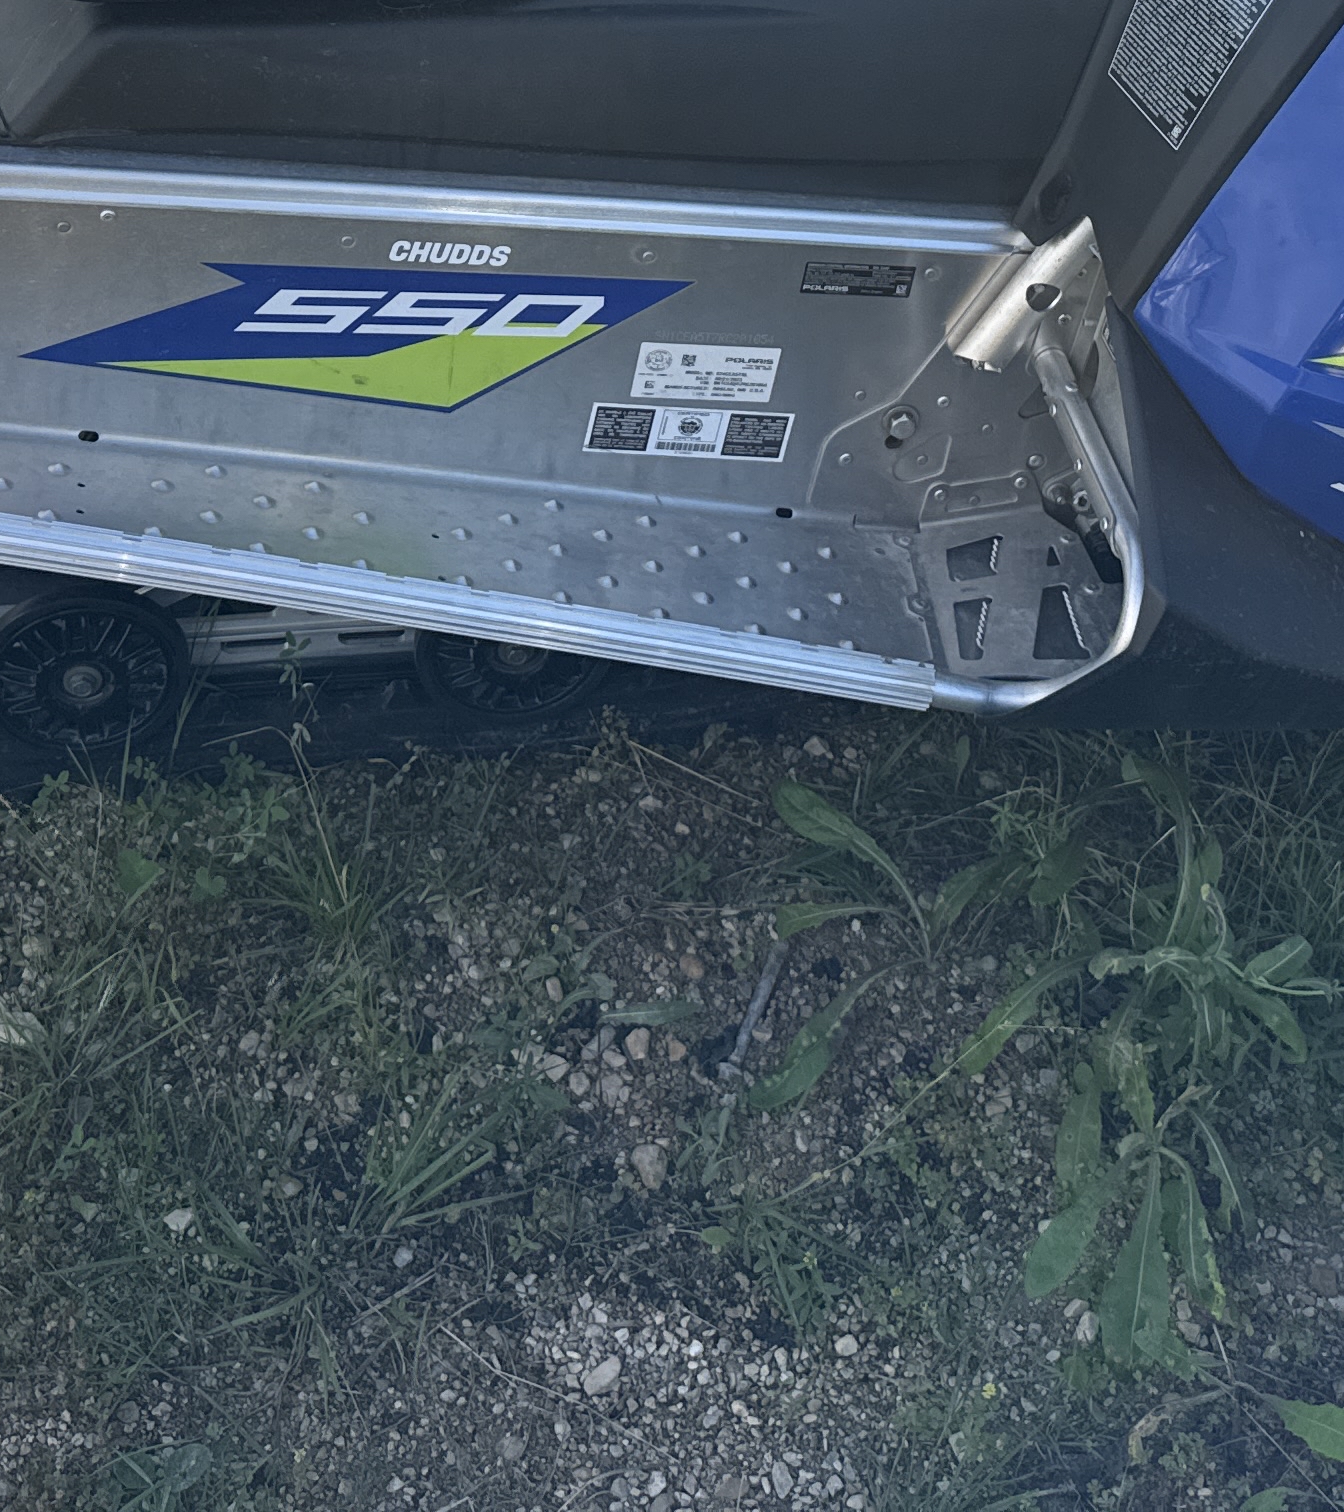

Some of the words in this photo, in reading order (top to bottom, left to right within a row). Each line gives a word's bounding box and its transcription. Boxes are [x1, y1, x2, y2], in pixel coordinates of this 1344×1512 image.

[388, 240, 511, 267] CHUDDS
[802, 284, 849, 293] POLARIS
[234, 289, 605, 336] 550
[725, 356, 774, 365] POLARIS
